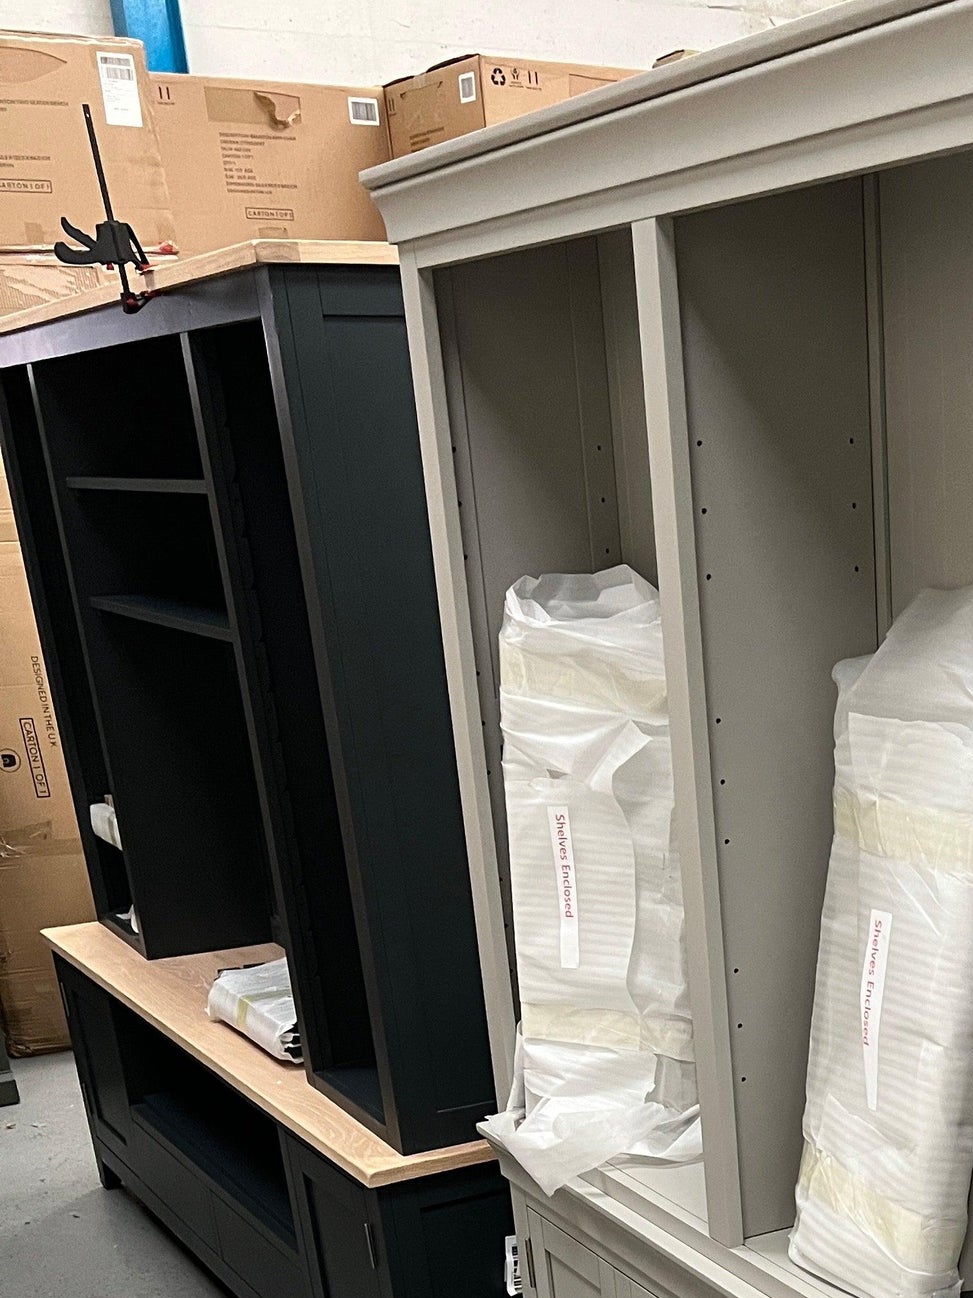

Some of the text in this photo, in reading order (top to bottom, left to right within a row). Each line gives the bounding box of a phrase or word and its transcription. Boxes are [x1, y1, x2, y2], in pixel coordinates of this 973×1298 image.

[31, 656, 48, 702] DESIGNED
[42, 703, 49, 714] IN
[44, 714, 54, 732] THE
[23, 721, 40, 762] CARTON
[35, 774, 46, 787] OF
[555, 814, 574, 918] Shelves Enclosed
[863, 920, 882, 1046] Shelves Enclosed
